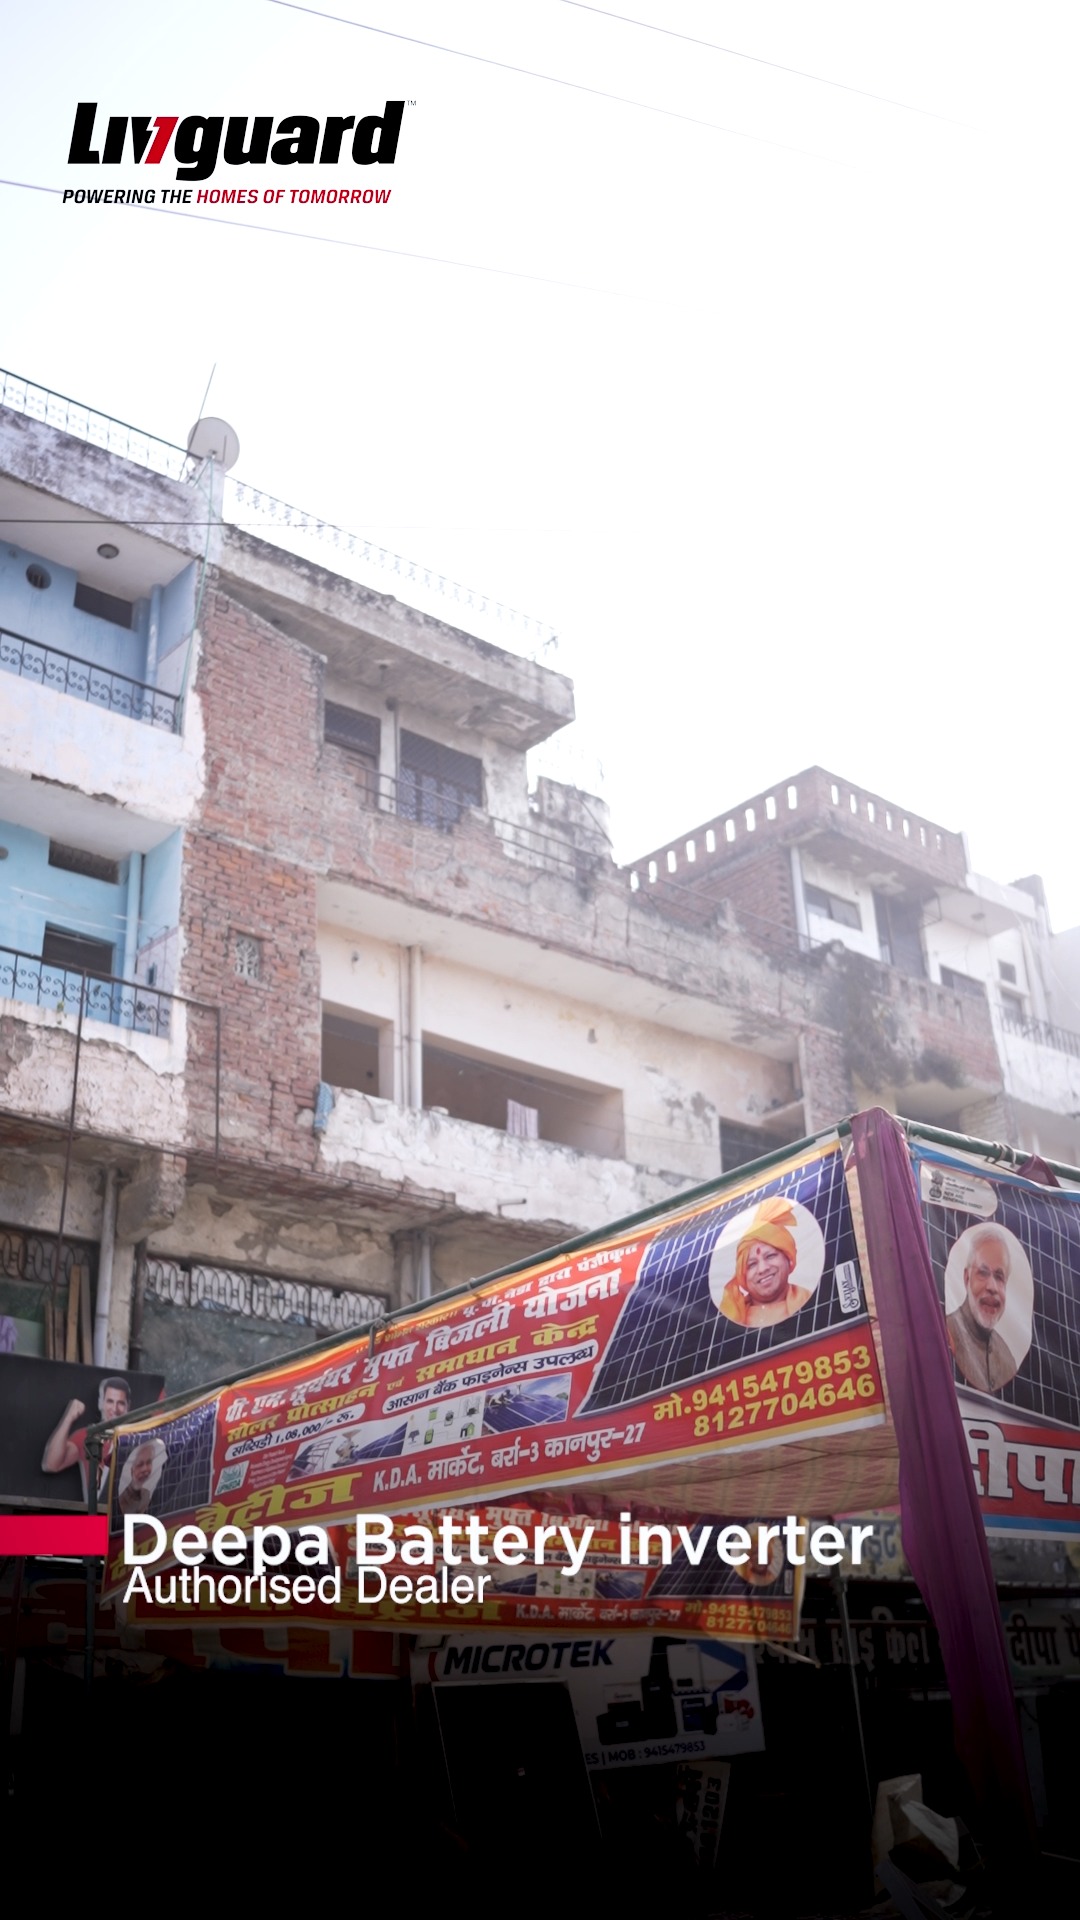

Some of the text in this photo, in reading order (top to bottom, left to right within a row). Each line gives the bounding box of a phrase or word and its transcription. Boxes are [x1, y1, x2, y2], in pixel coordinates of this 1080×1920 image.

[363, 1340, 420, 1383] मुफ्त
[425, 1302, 515, 1358] बिजली
[523, 1268, 622, 1319] योजना
[227, 1413, 282, 1443] सोलर
[416, 1336, 521, 1383] समाधान
[531, 1315, 599, 1347] केन्द्र
[386, 1345, 595, 1412] आसान बैंक फाइनेन्स उपलब्ध
[693, 1373, 876, 1437] 8127704646
[373, 1463, 422, 1493] K.D.A.
[443, 1639, 615, 1675] MICROTEK
[1006, 1614, 1060, 1666] दीपा
[608, 1749, 636, 1762] MOB
[644, 1741, 706, 1758] 9415479853
